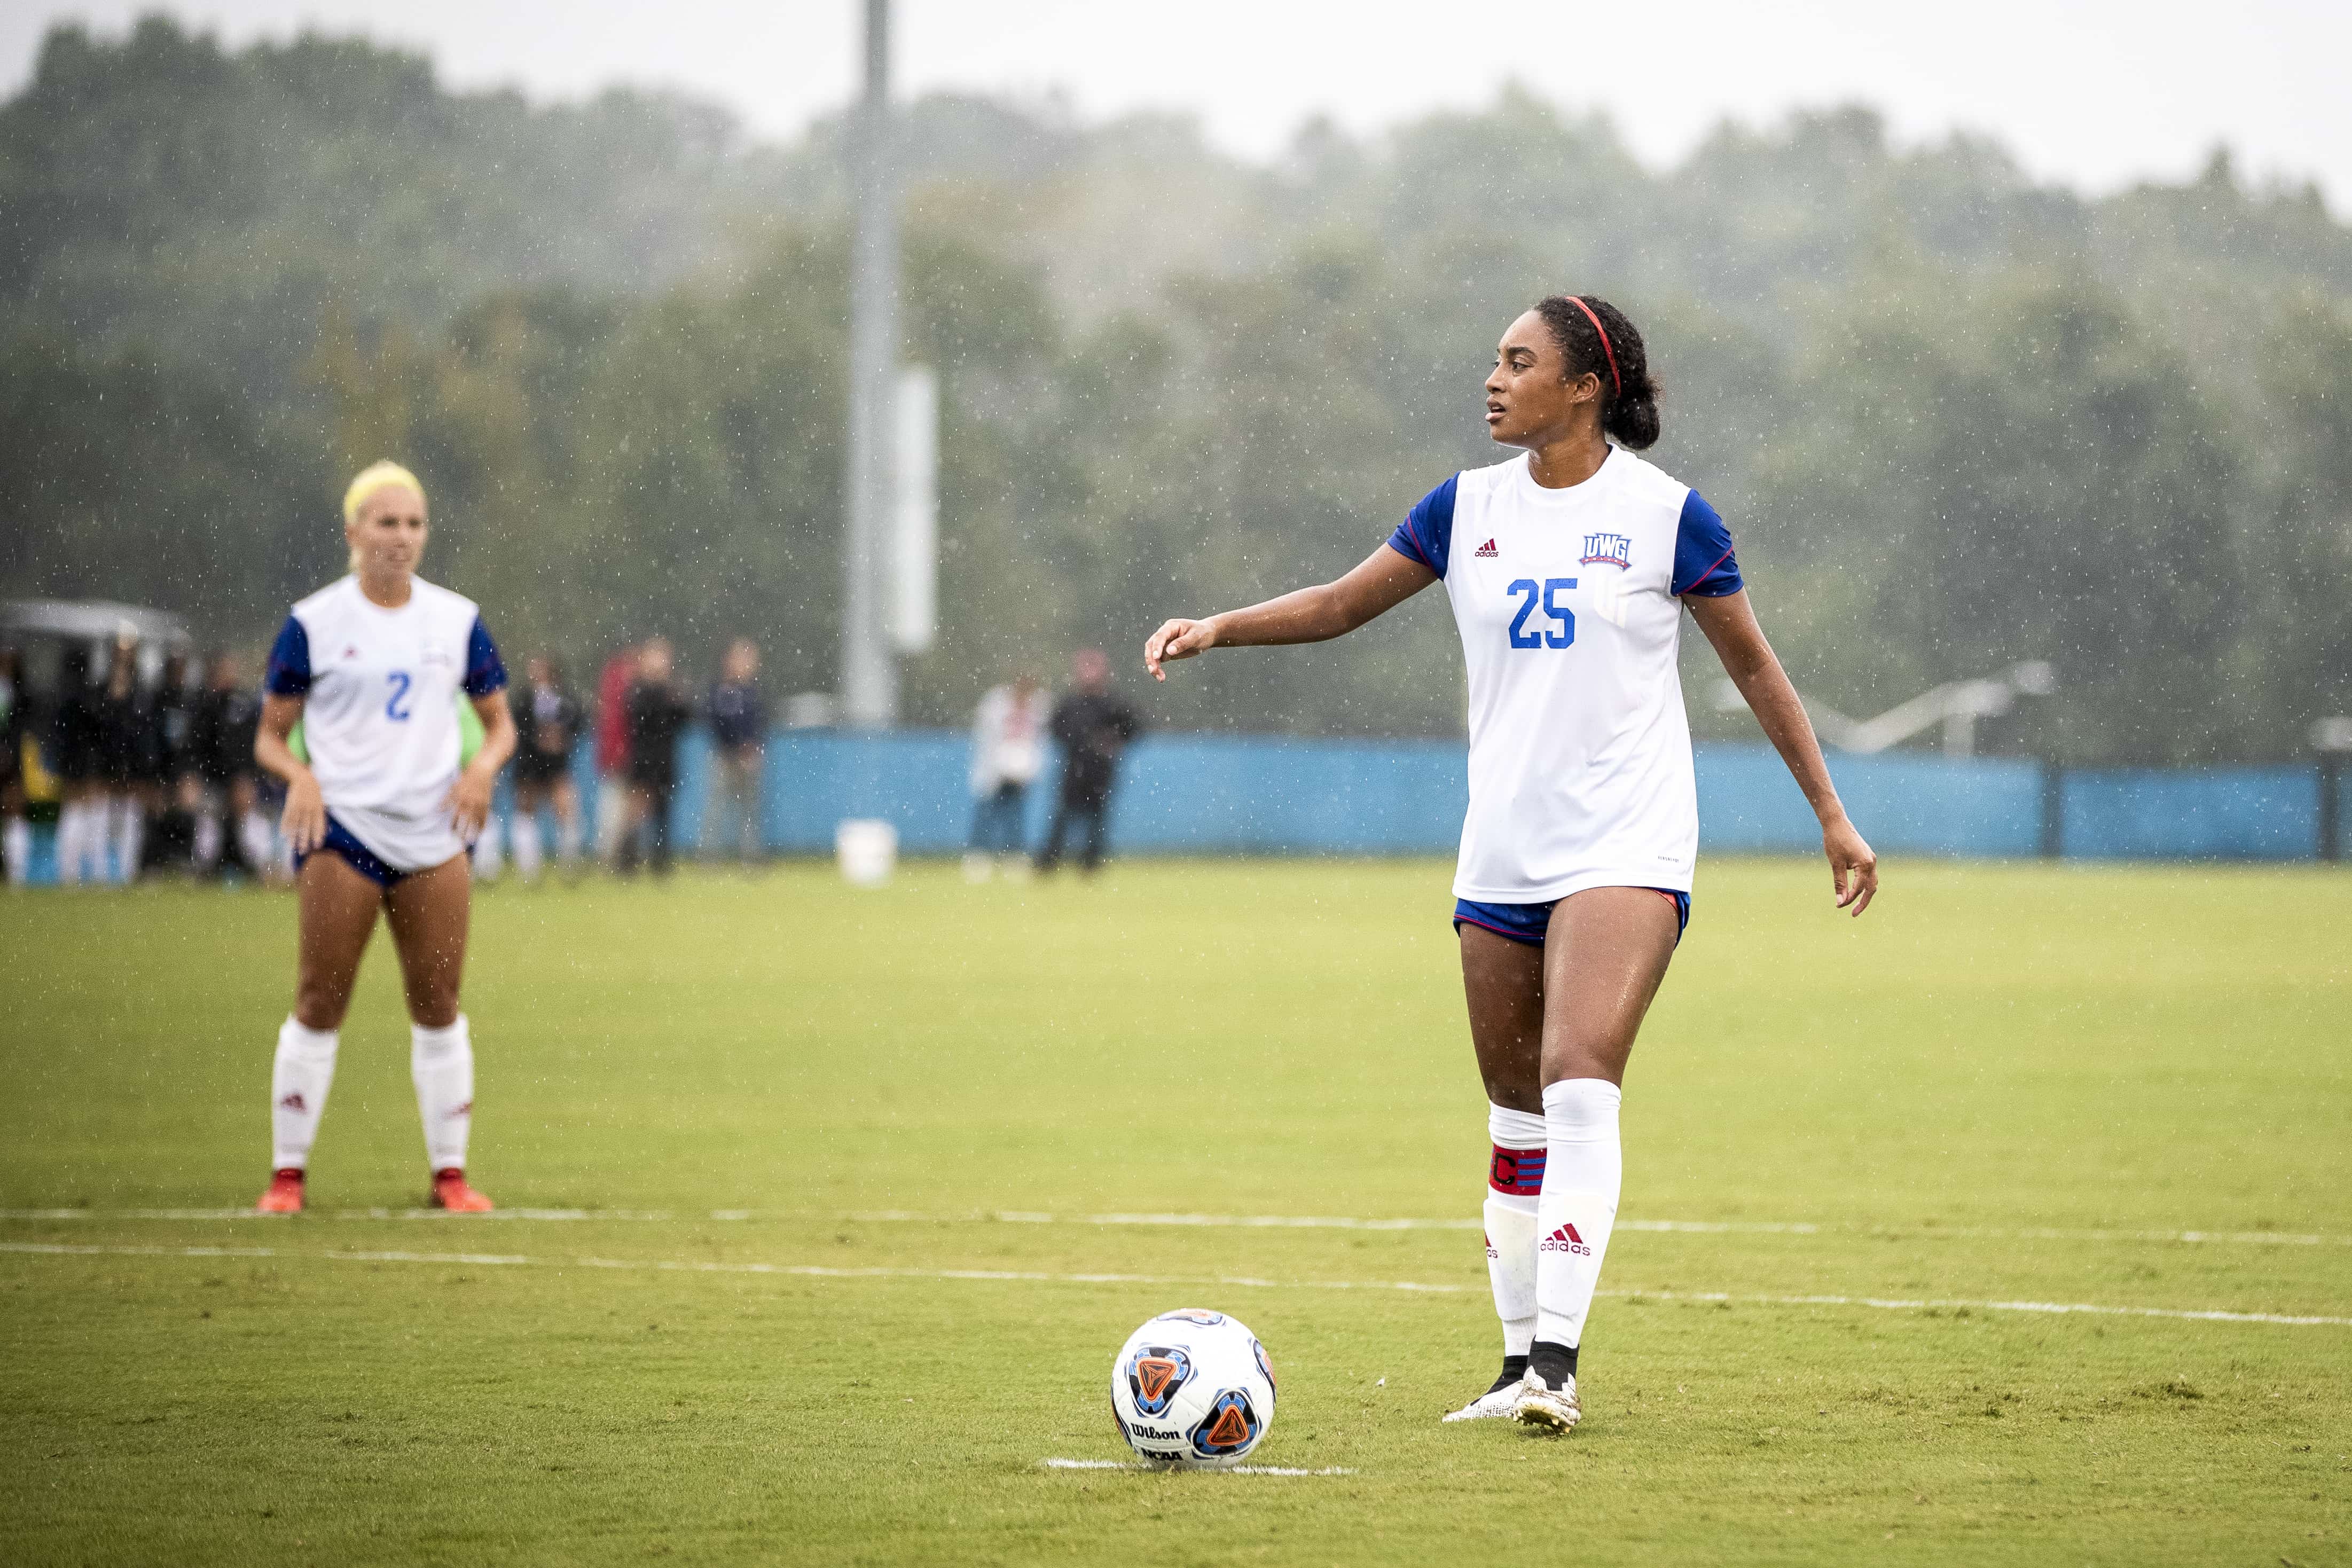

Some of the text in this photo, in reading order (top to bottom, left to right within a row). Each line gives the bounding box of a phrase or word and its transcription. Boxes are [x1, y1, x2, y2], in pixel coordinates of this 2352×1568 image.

[1475, 550, 1499, 558] adidas
[1585, 534, 1628, 562] UWG
[1507, 578, 1578, 649] 25
[386, 670, 411, 722] 2
[1493, 1152, 1516, 1185] C
[1540, 1240, 1590, 1256] adidas
[1131, 1422, 1181, 1440] Wilson
[1141, 1447, 1184, 1461] NCAA
